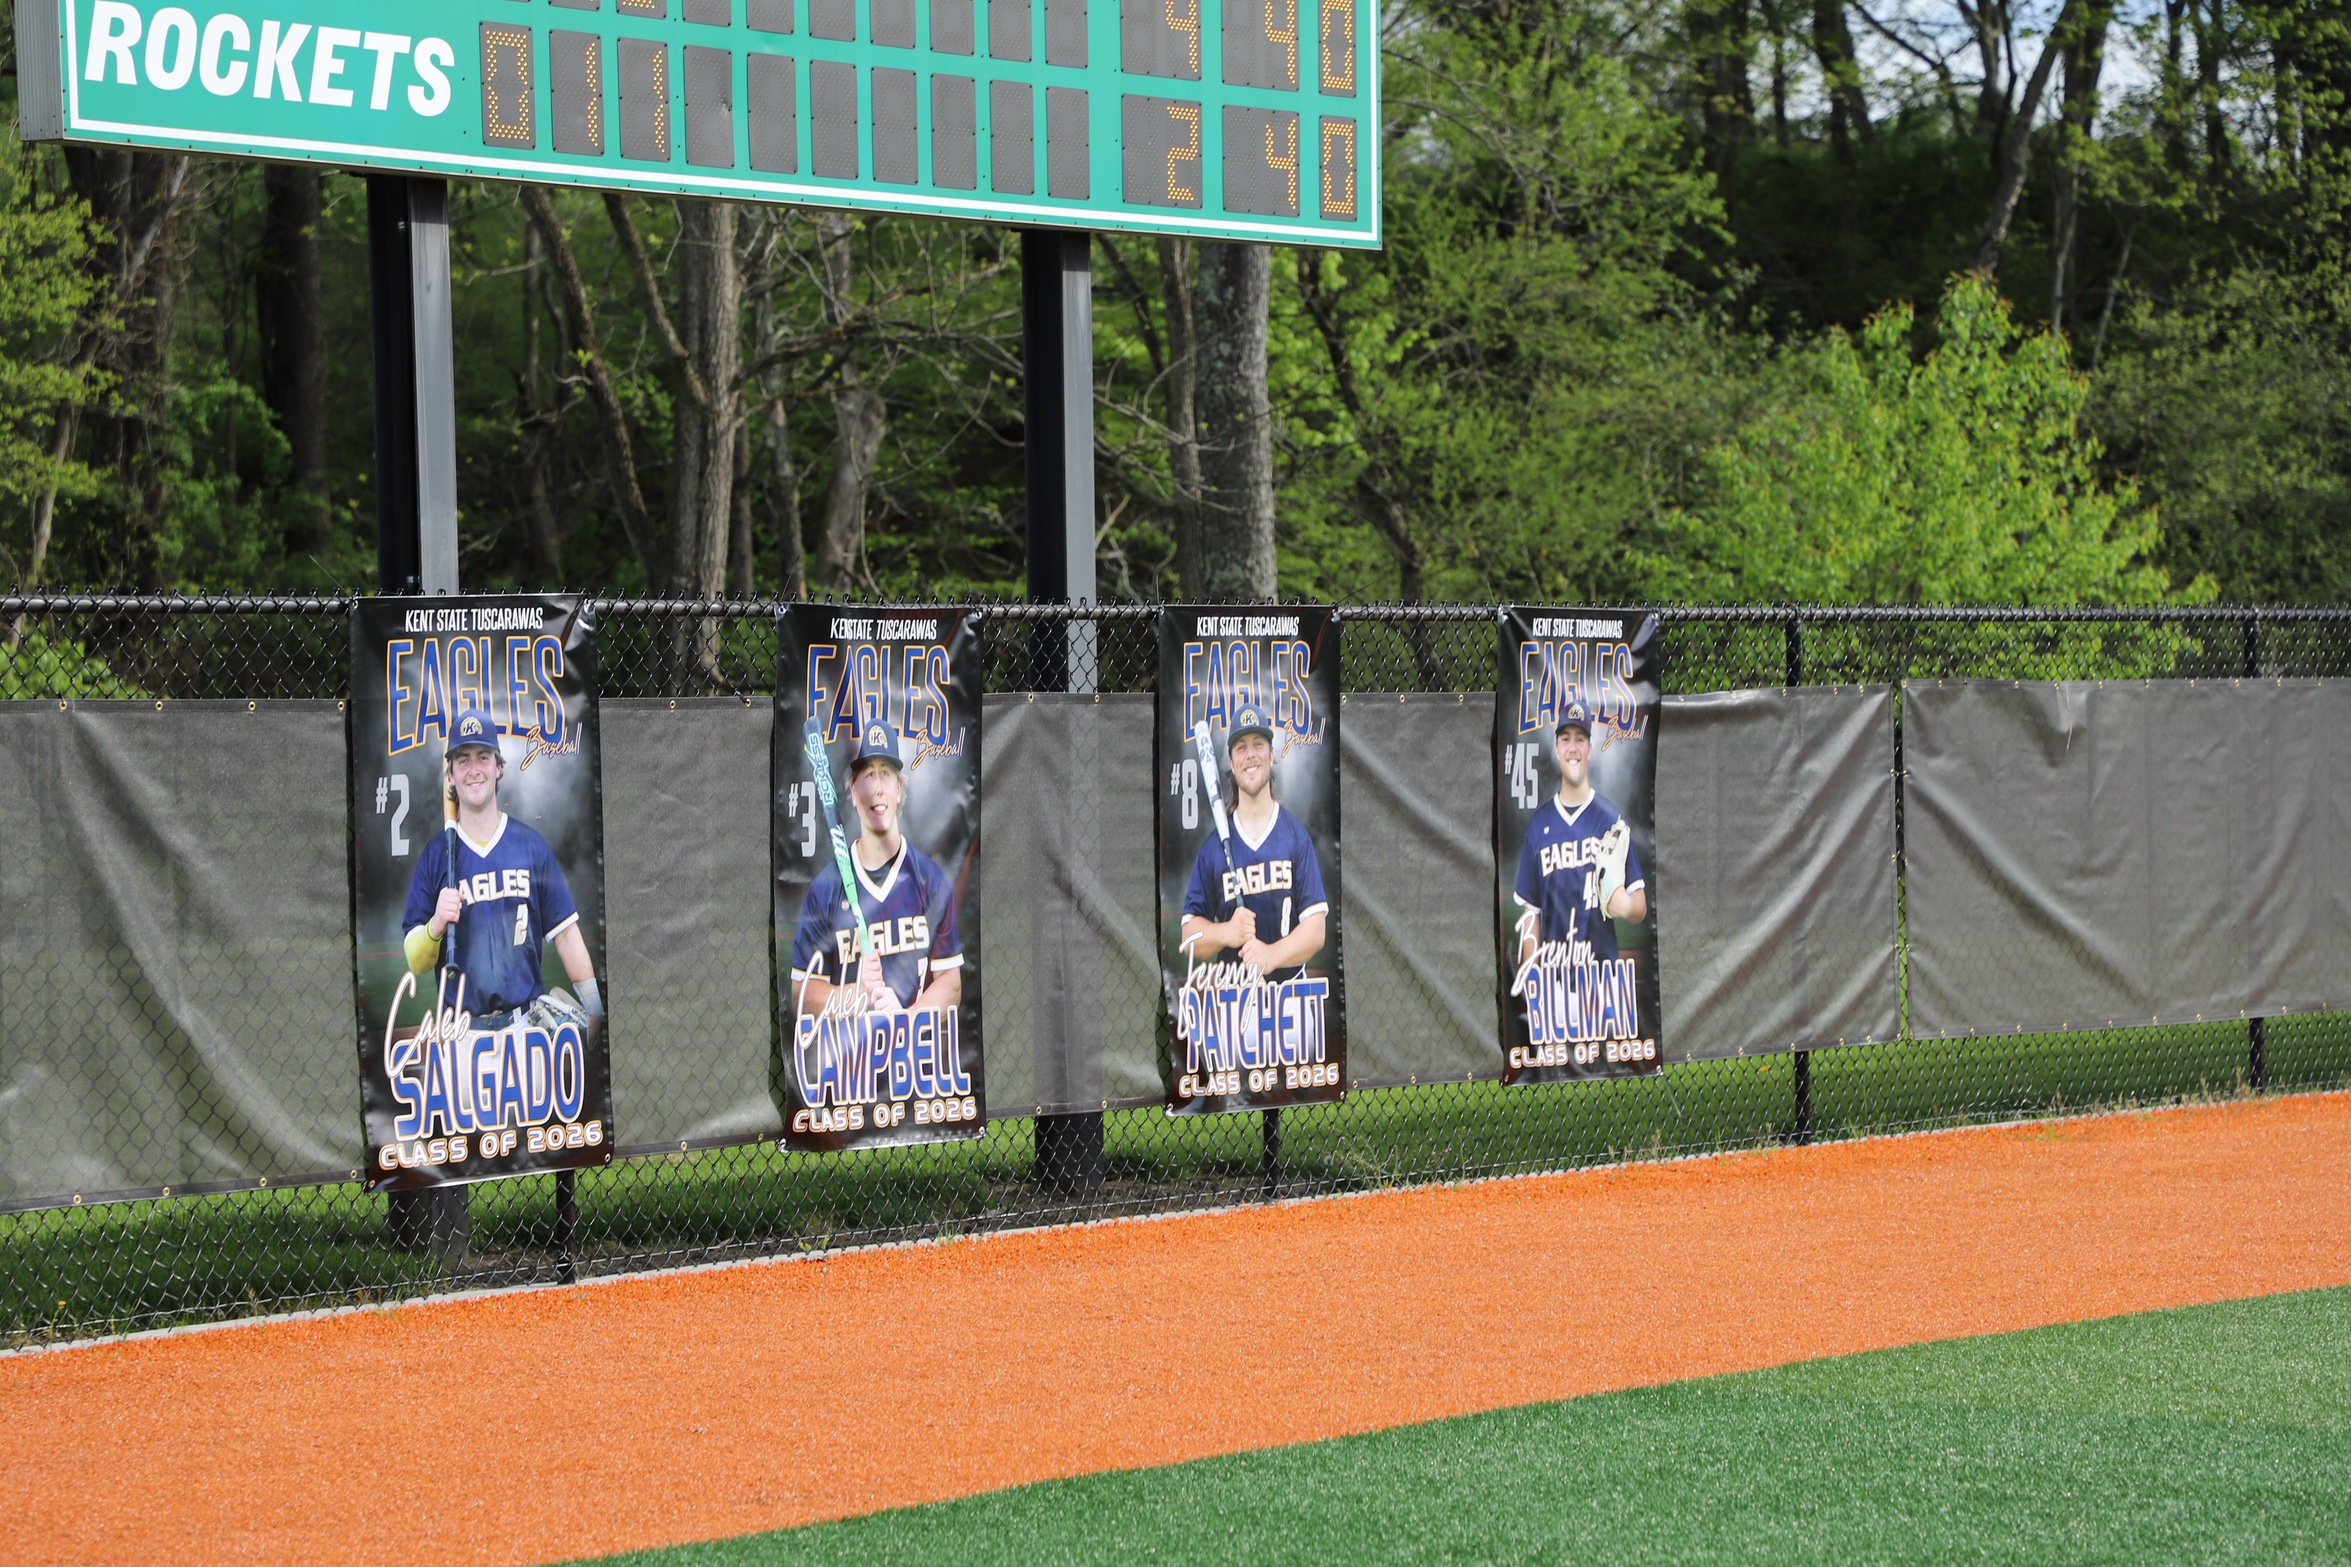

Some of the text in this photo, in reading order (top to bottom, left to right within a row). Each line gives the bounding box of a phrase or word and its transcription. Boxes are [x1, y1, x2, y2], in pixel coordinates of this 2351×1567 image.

[84, 1, 455, 118] ROCKETS
[1264, 0, 1297, 84] 4
[1322, 0, 1354, 90] 0
[486, 30, 1355, 214] 0 1 1 2 4 0
[405, 607, 544, 633] KENT STATE TUSCARAWAS
[876, 618, 937, 640] TUSCARAWAS
[1196, 616, 1299, 637] KENT STATE TUSCARAWAS
[1533, 618, 1623, 639] KENT STATE TUSCARAWAS
[386, 634, 566, 757] EAGLES
[805, 644, 951, 752] EAGLES
[1182, 640, 1312, 743] EAGLES
[1518, 641, 1637, 735] EAGLES
[520, 722, 583, 771] Baseball
[910, 727, 966, 771] Baseball
[1281, 717, 1327, 759] Baseball
[1601, 715, 1648, 752] Baseball
[1170, 759, 1199, 830] #8
[1505, 743, 1539, 809] #45
[375, 774, 410, 857] #2
[788, 781, 817, 857] #3
[457, 868, 530, 908] AGLES
[1222, 860, 1292, 902] EAGLES
[1540, 836, 1600, 877] EAGLES
[513, 903, 529, 947] 2
[1510, 907, 1596, 997] Brenton
[796, 950, 869, 1049] Caleb
[1177, 931, 1268, 1040] Jeremy
[1524, 958, 1639, 1045] BILLMAN
[383, 966, 472, 1079] Caleb
[794, 1005, 971, 1108] CAMPBELL
[1179, 977, 1329, 1074] PATCHETT
[1509, 1038, 1656, 1068] CLASS OF 2026
[390, 1023, 585, 1142] SALGADO
[792, 1096, 976, 1133] CLASS OF 2026
[1178, 1063, 1339, 1098] CLASS OF 2026
[379, 1120, 604, 1171] CLASS OF 2026
